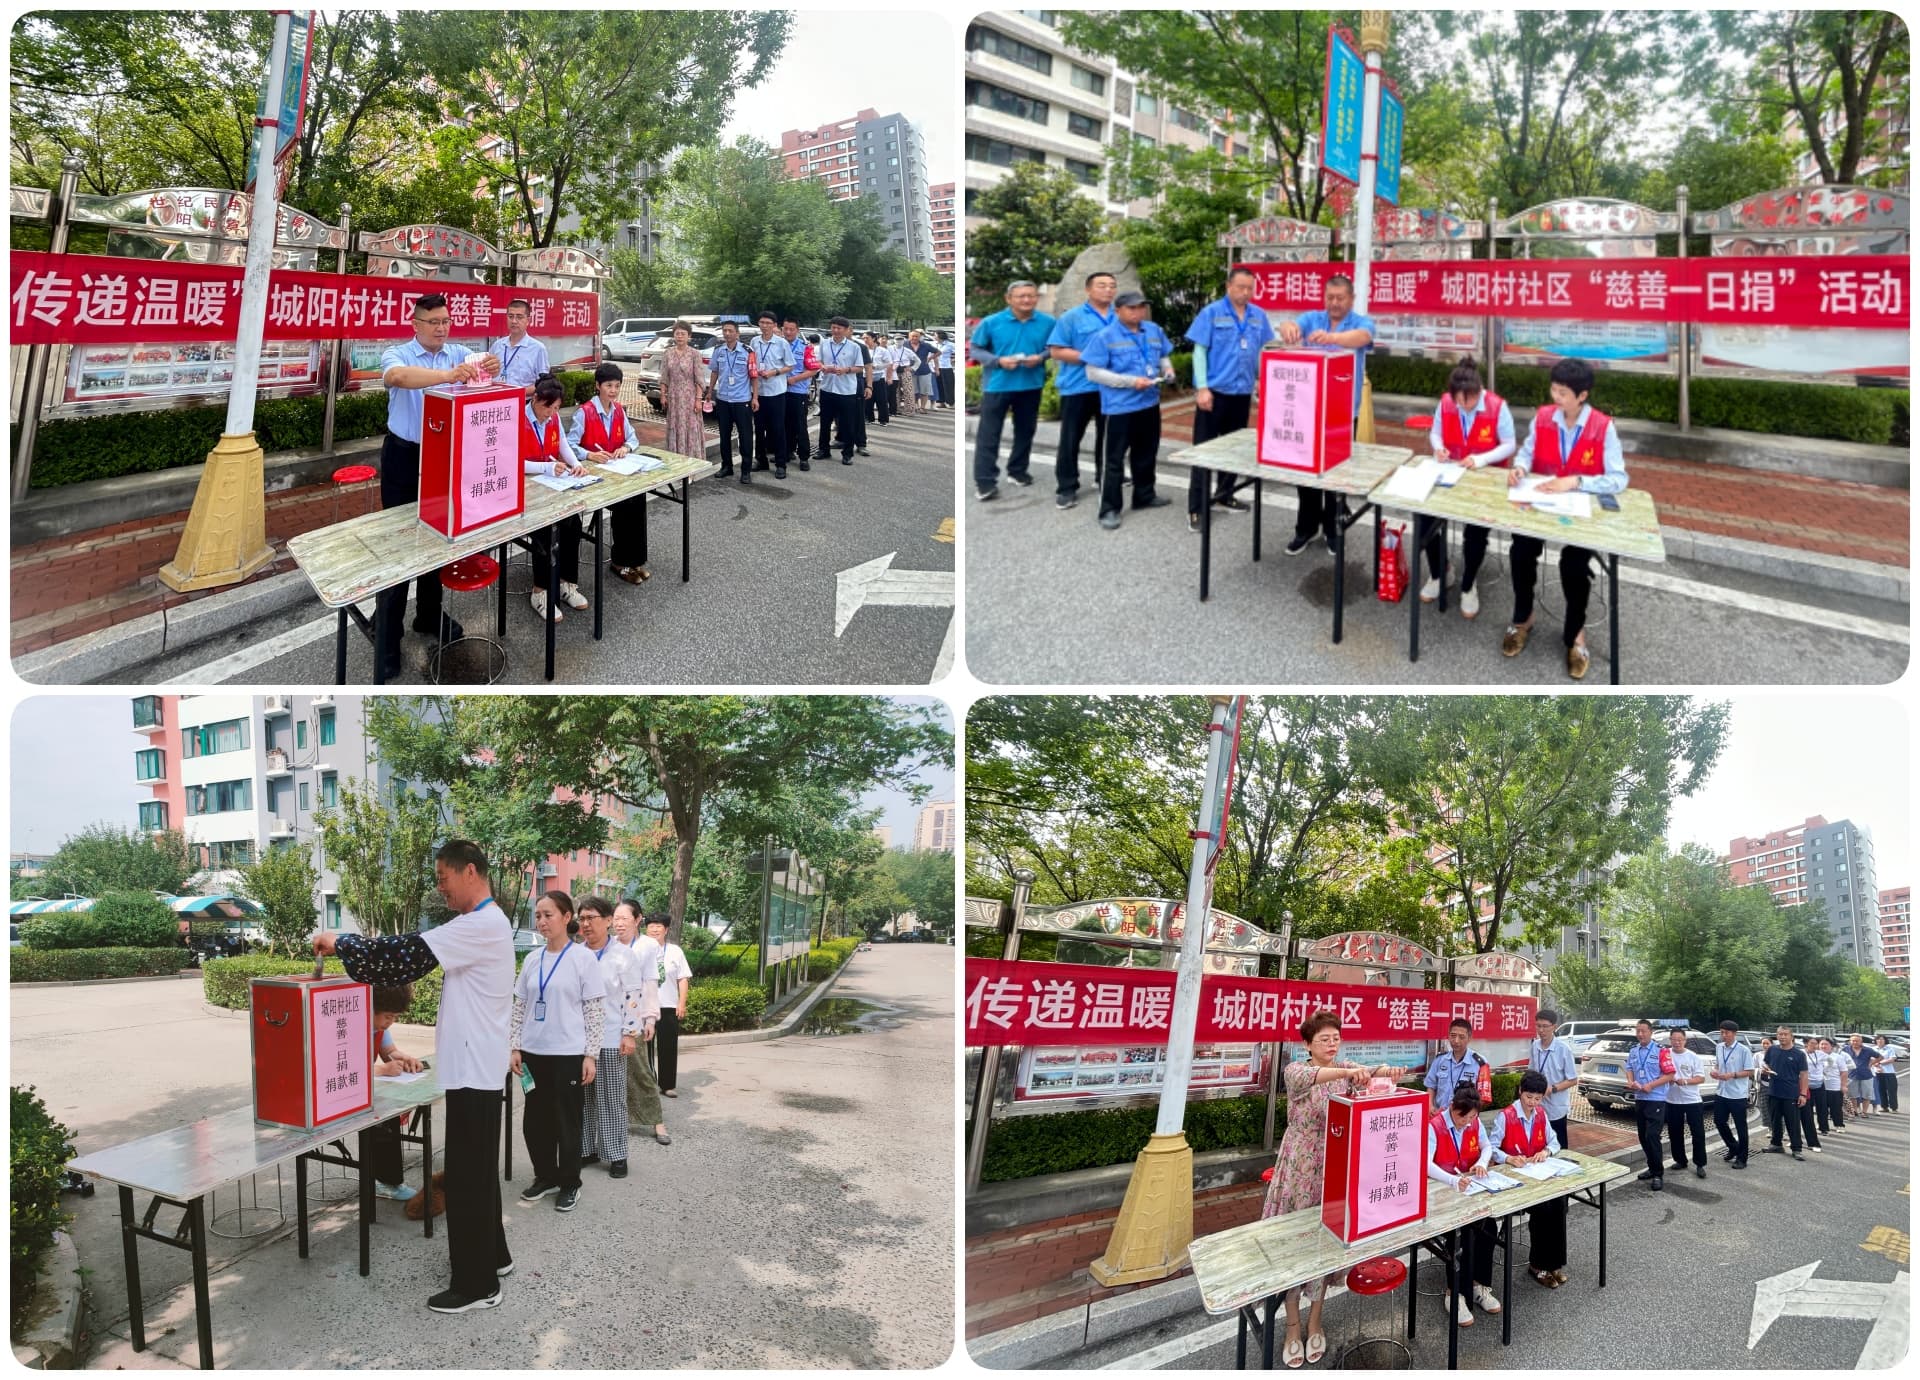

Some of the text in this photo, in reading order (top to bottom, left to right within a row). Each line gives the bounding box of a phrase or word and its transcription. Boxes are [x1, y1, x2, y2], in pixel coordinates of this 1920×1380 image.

[1441, 270, 1573, 307] 城阳村社区
[1589, 268, 1796, 312] “慈善一日捐”
[1818, 269, 1901, 314] 活动
[269, 285, 424, 327] 城阳村社区
[440, 292, 554, 327] “慈善一捐”
[562, 300, 590, 327] 活动
[470, 405, 512, 427] 城阳村社区
[483, 425, 498, 477] 慈善一日捐
[470, 476, 508, 498] 捐款箱
[321, 995, 360, 1018] 城阳村社区
[1501, 1004, 1529, 1031] 活动
[335, 1017, 348, 1072] 慈善一日捐
[325, 1072, 359, 1094] 捐款箱
[1369, 1111, 1414, 1133] 城阳村社区
[1383, 1131, 1398, 1182] 慈善一日捐
[1368, 1181, 1409, 1204] 捐款箱
